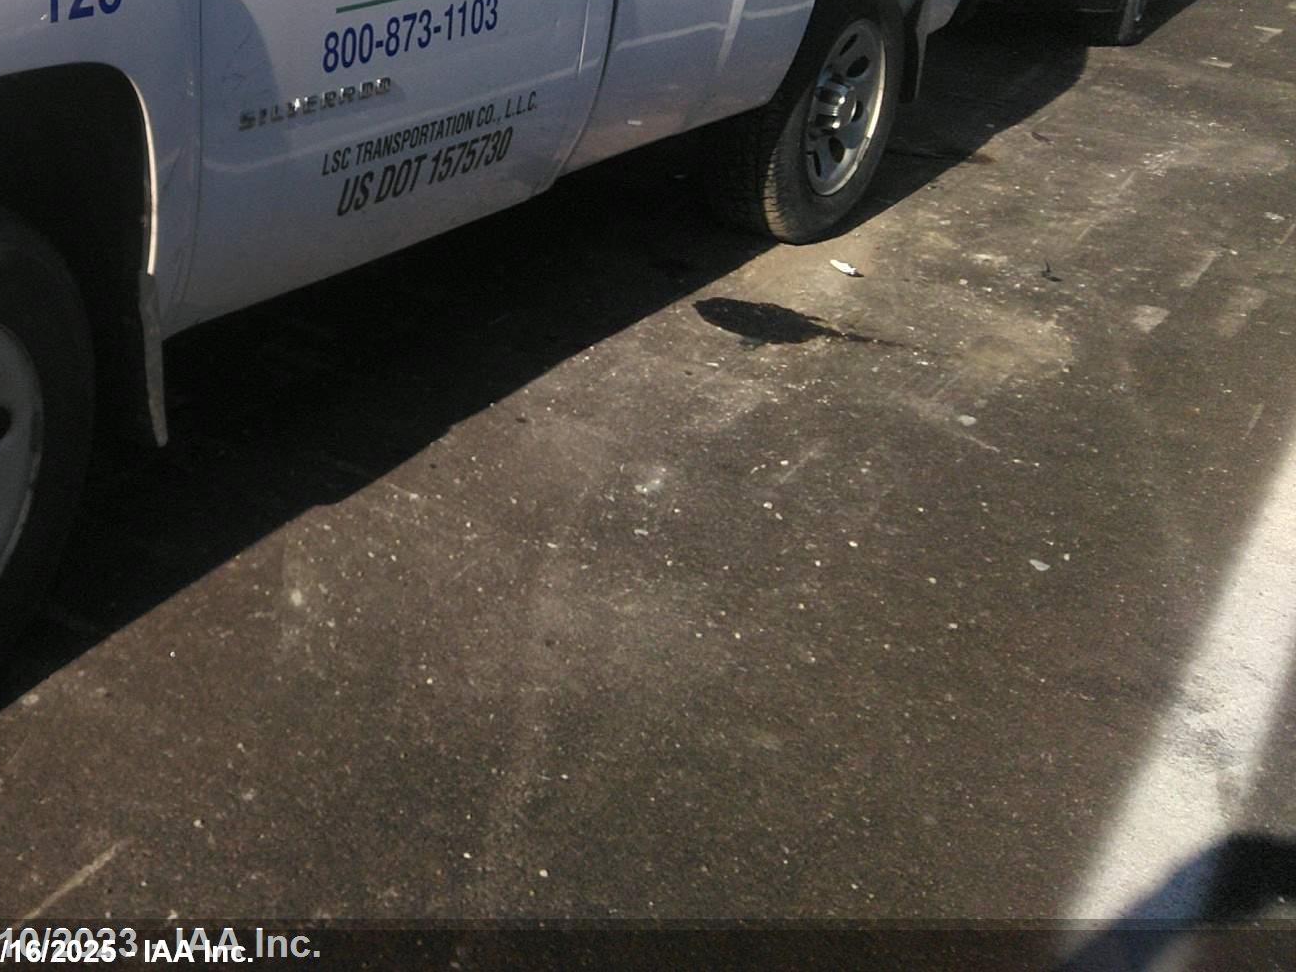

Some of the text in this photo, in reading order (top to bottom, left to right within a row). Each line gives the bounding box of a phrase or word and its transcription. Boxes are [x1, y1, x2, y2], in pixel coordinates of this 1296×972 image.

[322, 146, 352, 176] LSC
[356, 109, 476, 166] TRANSPORTATION
[505, 91, 538, 119] L.L.C.
[337, 126, 514, 217] US DOT 1575730
